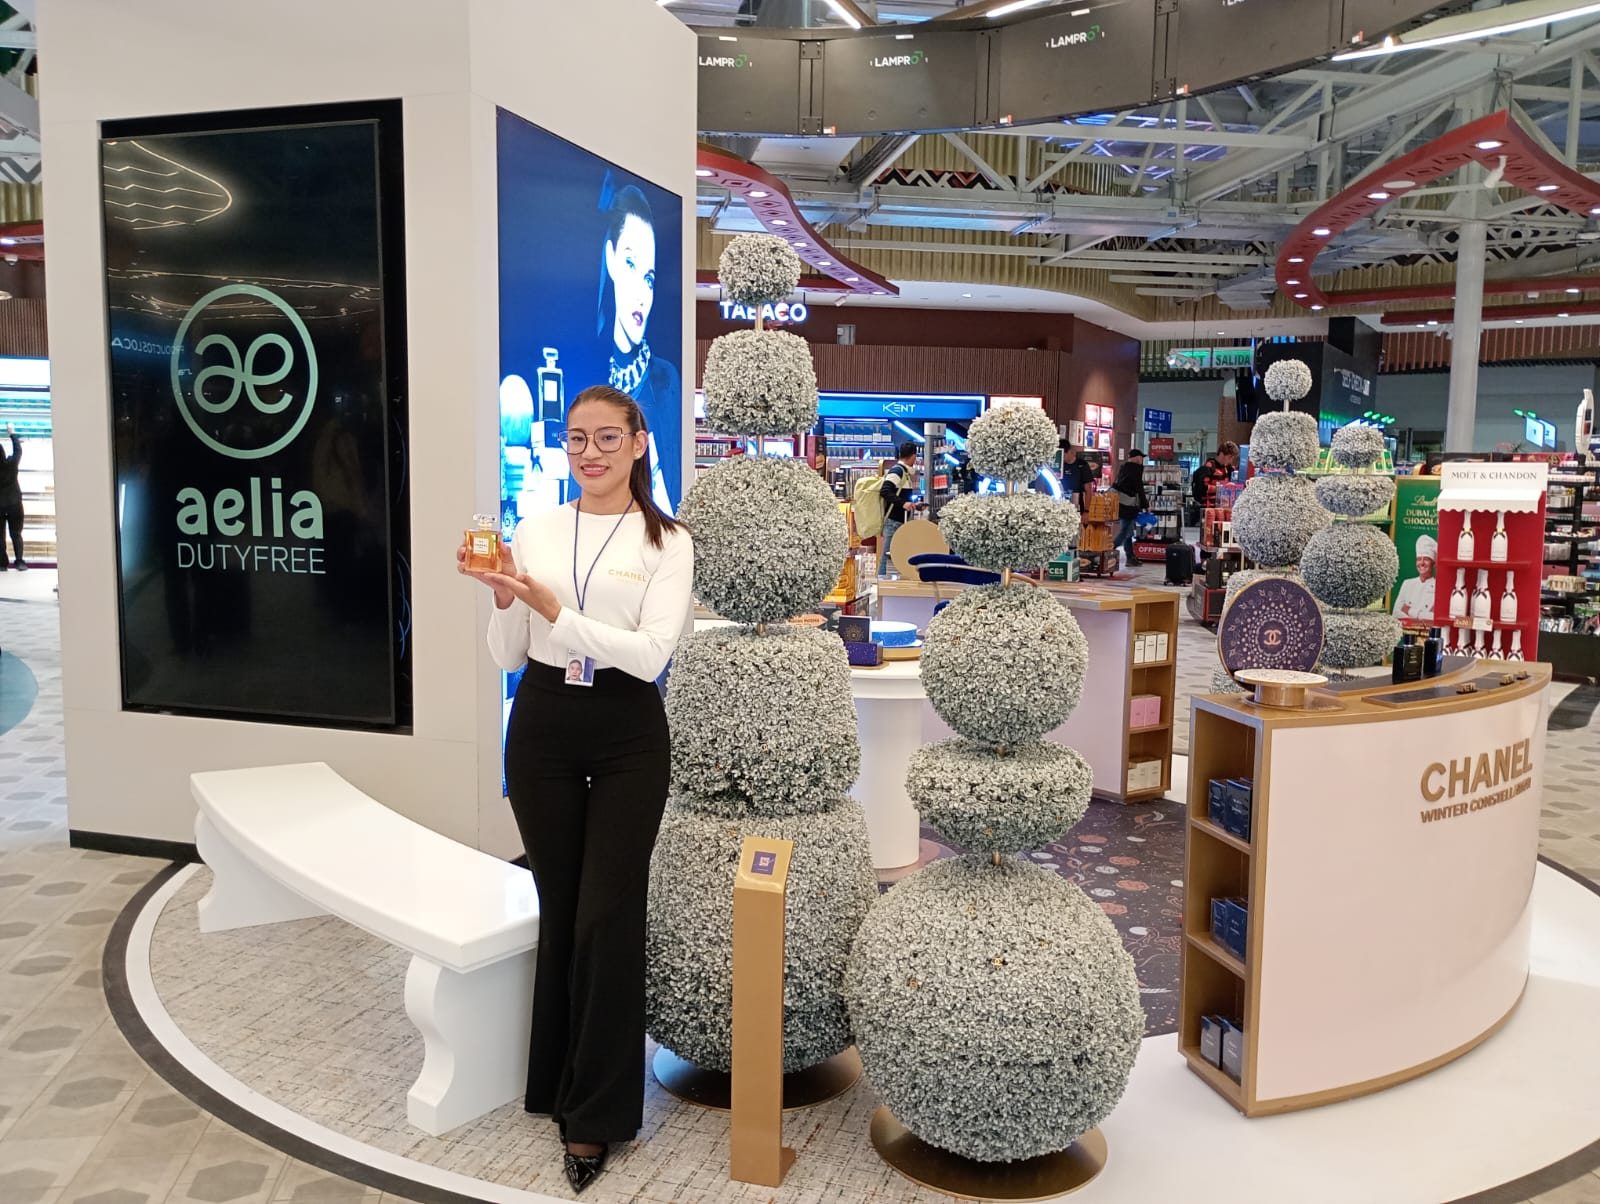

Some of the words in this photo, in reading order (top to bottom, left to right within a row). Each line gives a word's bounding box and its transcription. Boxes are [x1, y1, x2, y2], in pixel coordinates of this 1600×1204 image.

[1215, 355, 1250, 366] SALIDA
[882, 401, 916, 418] KENT
[1480, 471, 1487, 480] &
[1489, 471, 1537, 480] CHANDON
[175, 477, 324, 539] aelia
[1138, 546, 1167, 554] OFFERS
[177, 543, 327, 575] DUTYFREE
[607, 568, 648, 582] CHANEL
[1420, 737, 1533, 802] CHANEL
[1420, 802, 1468, 824] WINTER
